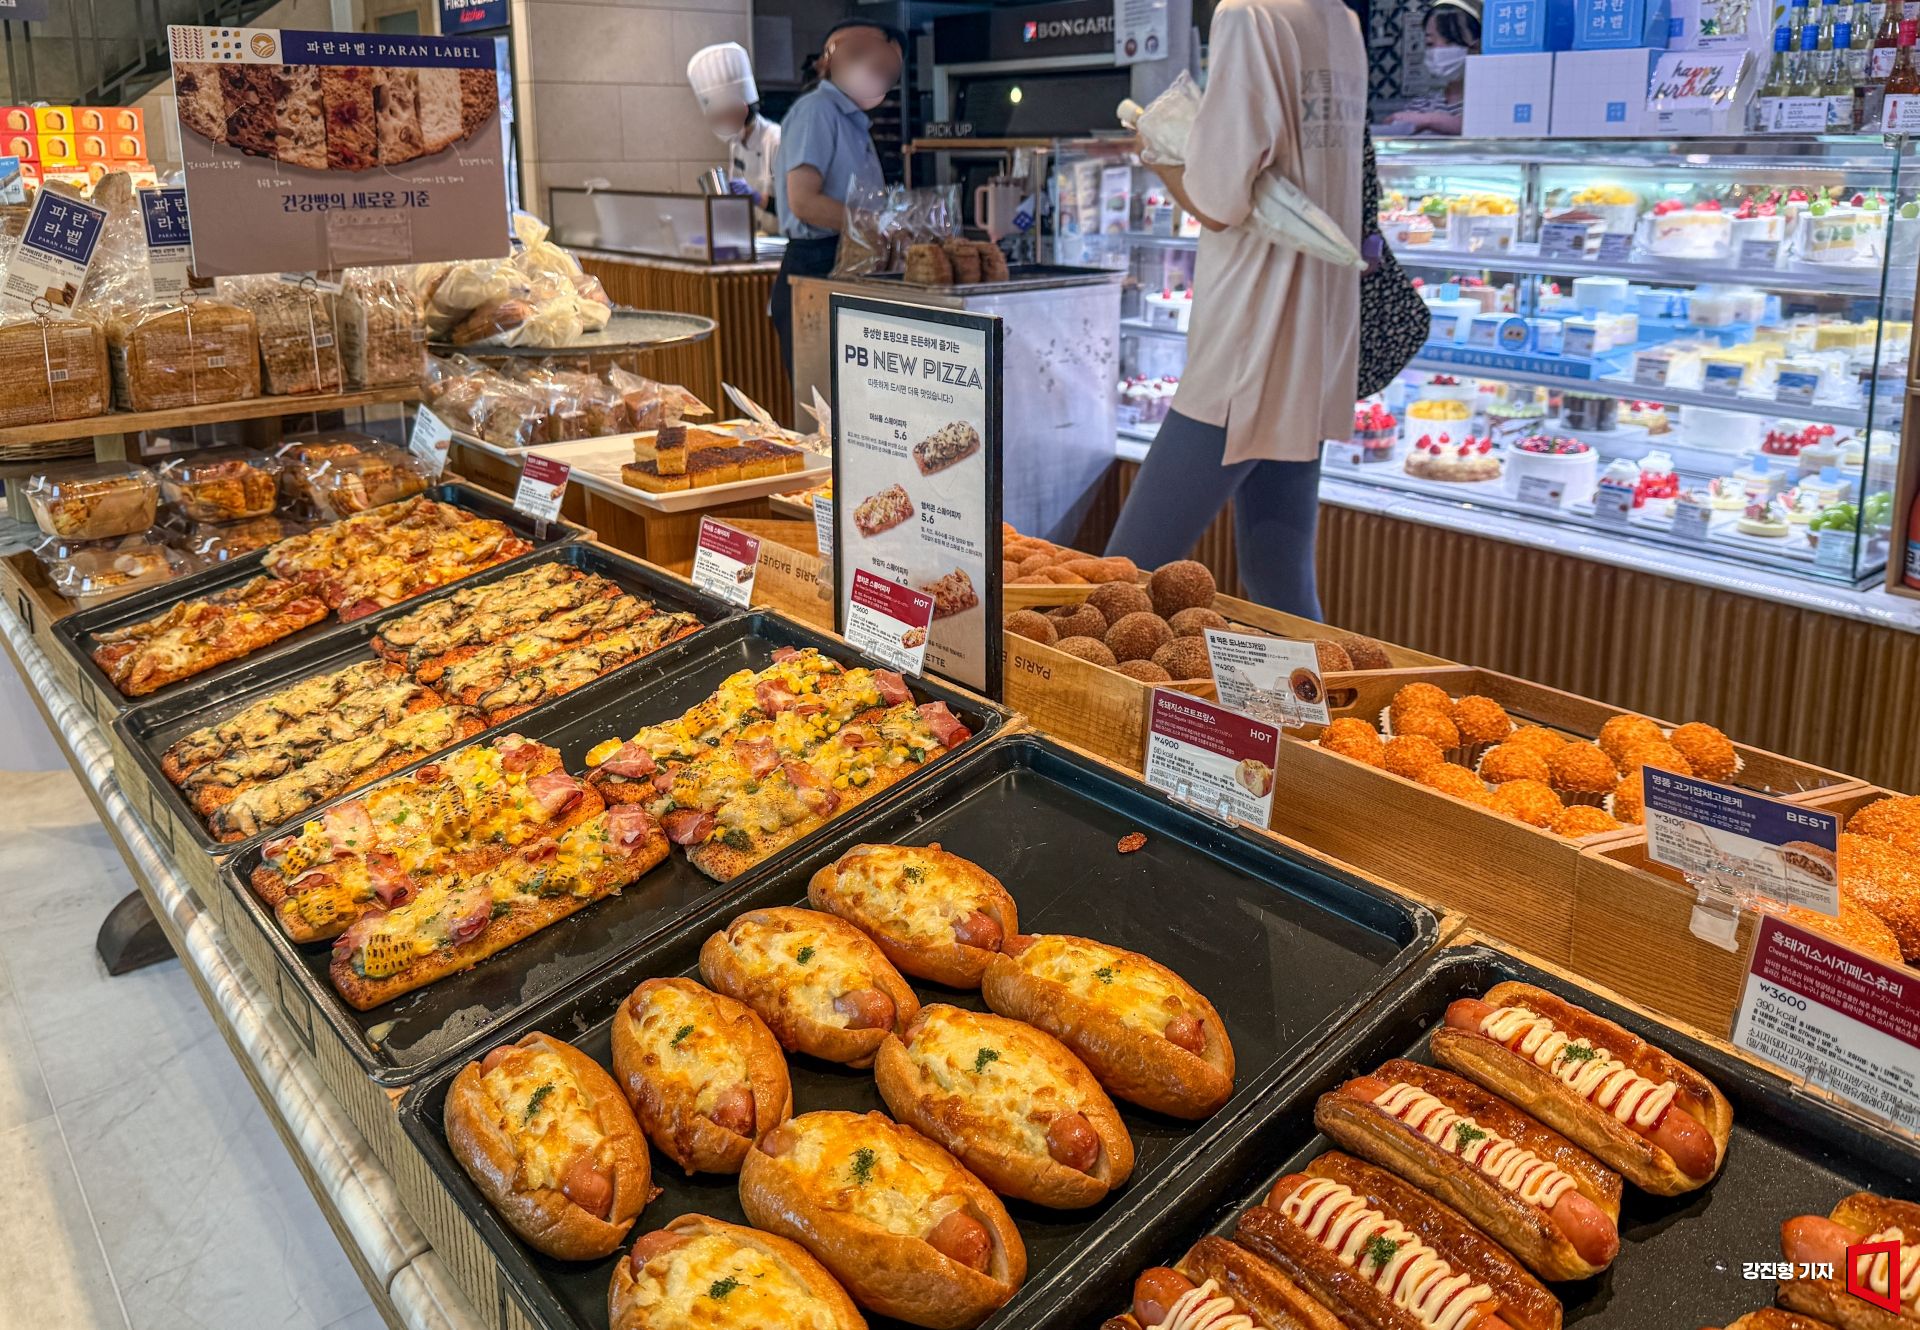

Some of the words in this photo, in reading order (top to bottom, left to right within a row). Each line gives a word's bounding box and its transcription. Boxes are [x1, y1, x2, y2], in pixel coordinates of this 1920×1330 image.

[379, 44, 428, 56] PARAN
[435, 47, 480, 59] LABEL
[1672, 60, 1724, 80] happy
[926, 122, 952, 137] PICK
[955, 121, 972, 136] UP
[281, 193, 346, 213] 건강빵의
[352, 191, 397, 209] 새로운
[402, 190, 430, 208] 기준
[49, 204, 89, 229] 파란
[37, 236, 59, 248] PARAN
[44, 222, 83, 247] 라벨
[863, 327, 881, 340] 풍성한
[883, 331, 909, 345] 토핑으로
[910, 334, 938, 350] 든든하게
[939, 338, 960, 354] 즐기는
[845, 344, 869, 367] PB
[873, 349, 918, 377] NEW
[923, 358, 983, 390] PIZZA
[868, 378, 889, 391] 따뜻하게
[890, 382, 907, 394] 드시면
[908, 385, 919, 397] 더욱
[894, 429, 907, 440] 5.6
[921, 512, 935, 525] 5.6
[746, 539, 758, 549] HOT
[914, 598, 929, 609] HOT
[1014, 656, 1051, 681] PARIS
[1154, 735, 1180, 750] ₩4900
[1250, 728, 1272, 743] HOT
[1652, 774, 1671, 788] 명품
[1786, 811, 1830, 831] BEST
[1768, 945, 1789, 959] Cheese
[1789, 954, 1813, 971] Sausage
[1813, 964, 1833, 981] Pastry
[1771, 930, 1904, 999] 흑돼지소시지페스츄리
[1760, 982, 1807, 1011] ₩3600
[1803, 983, 1819, 997] 누구나
[1755, 998, 1775, 1013] 390
[1776, 1007, 1798, 1024] kcal
